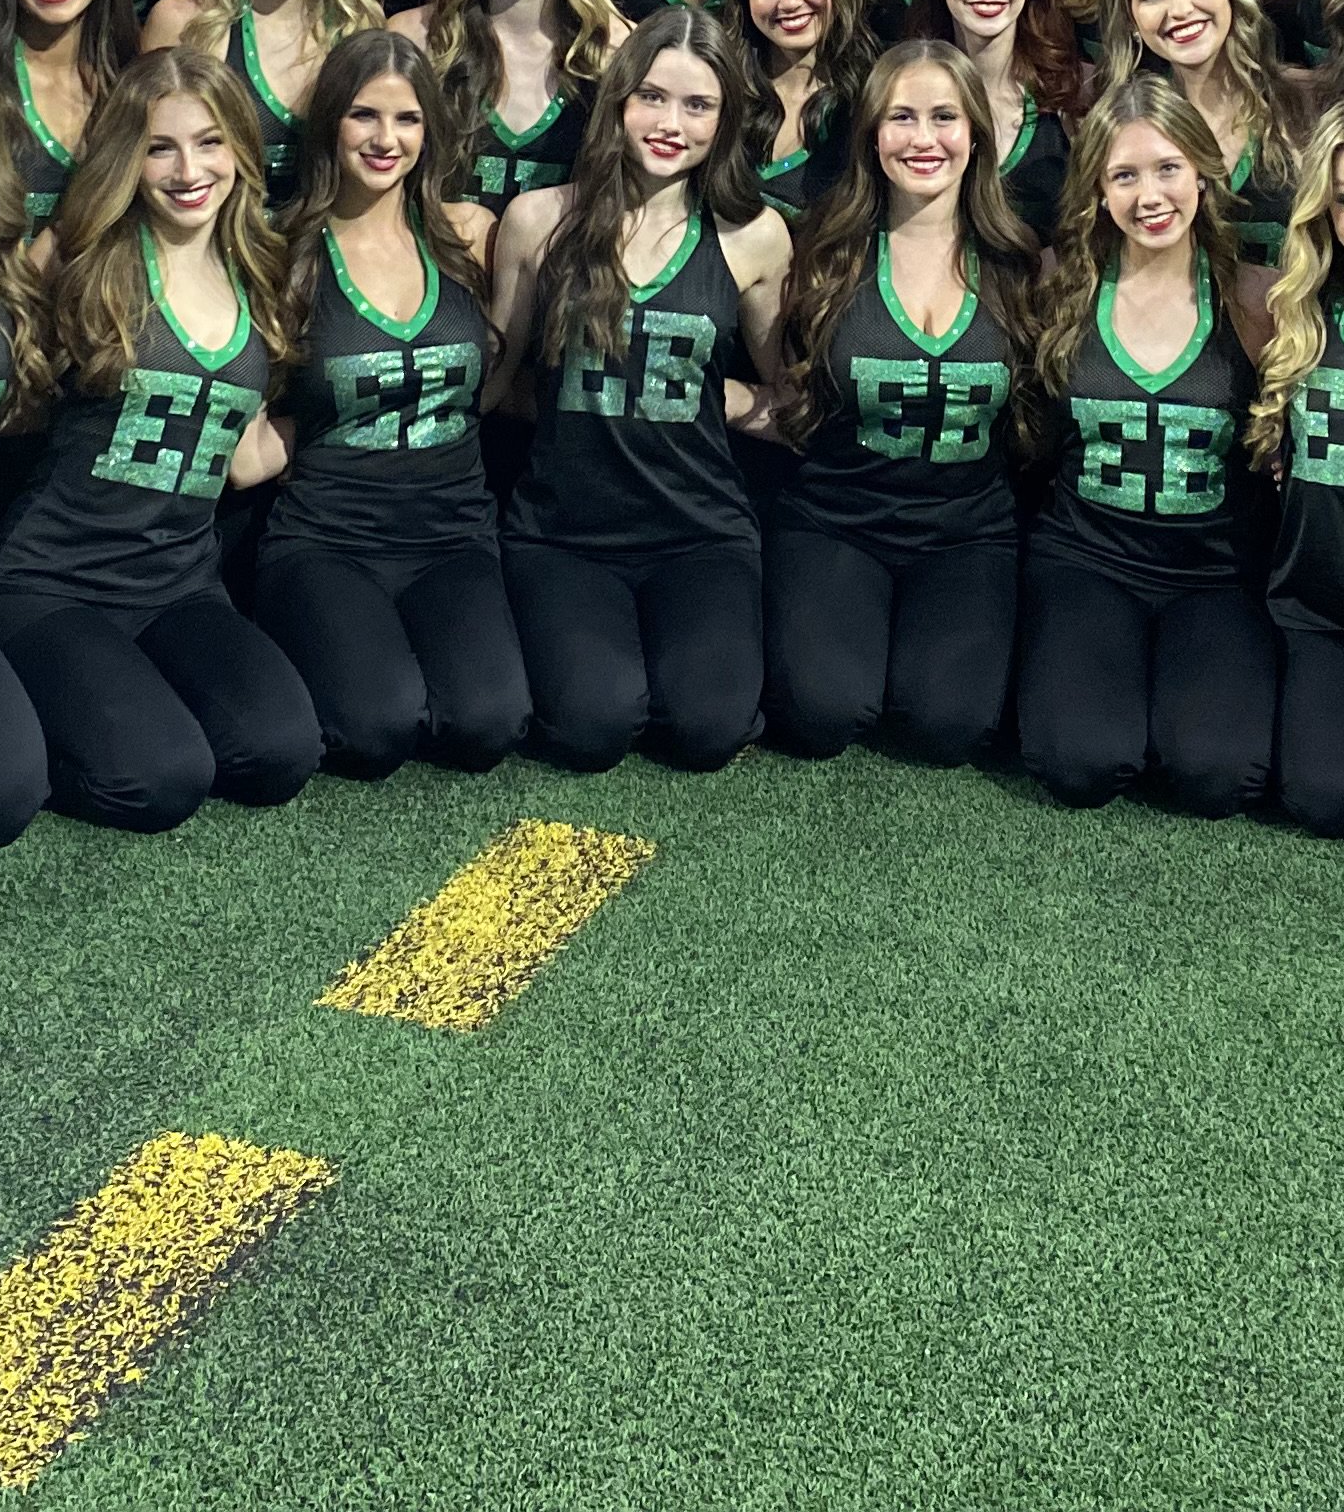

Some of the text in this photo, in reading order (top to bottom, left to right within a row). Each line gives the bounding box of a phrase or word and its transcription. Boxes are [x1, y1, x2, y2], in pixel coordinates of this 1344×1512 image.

[320, 341, 483, 451] EB
[558, 307, 717, 423] EB
[850, 357, 1012, 464] EB
[91, 367, 263, 500] EB
[1070, 397, 1235, 515] EB
